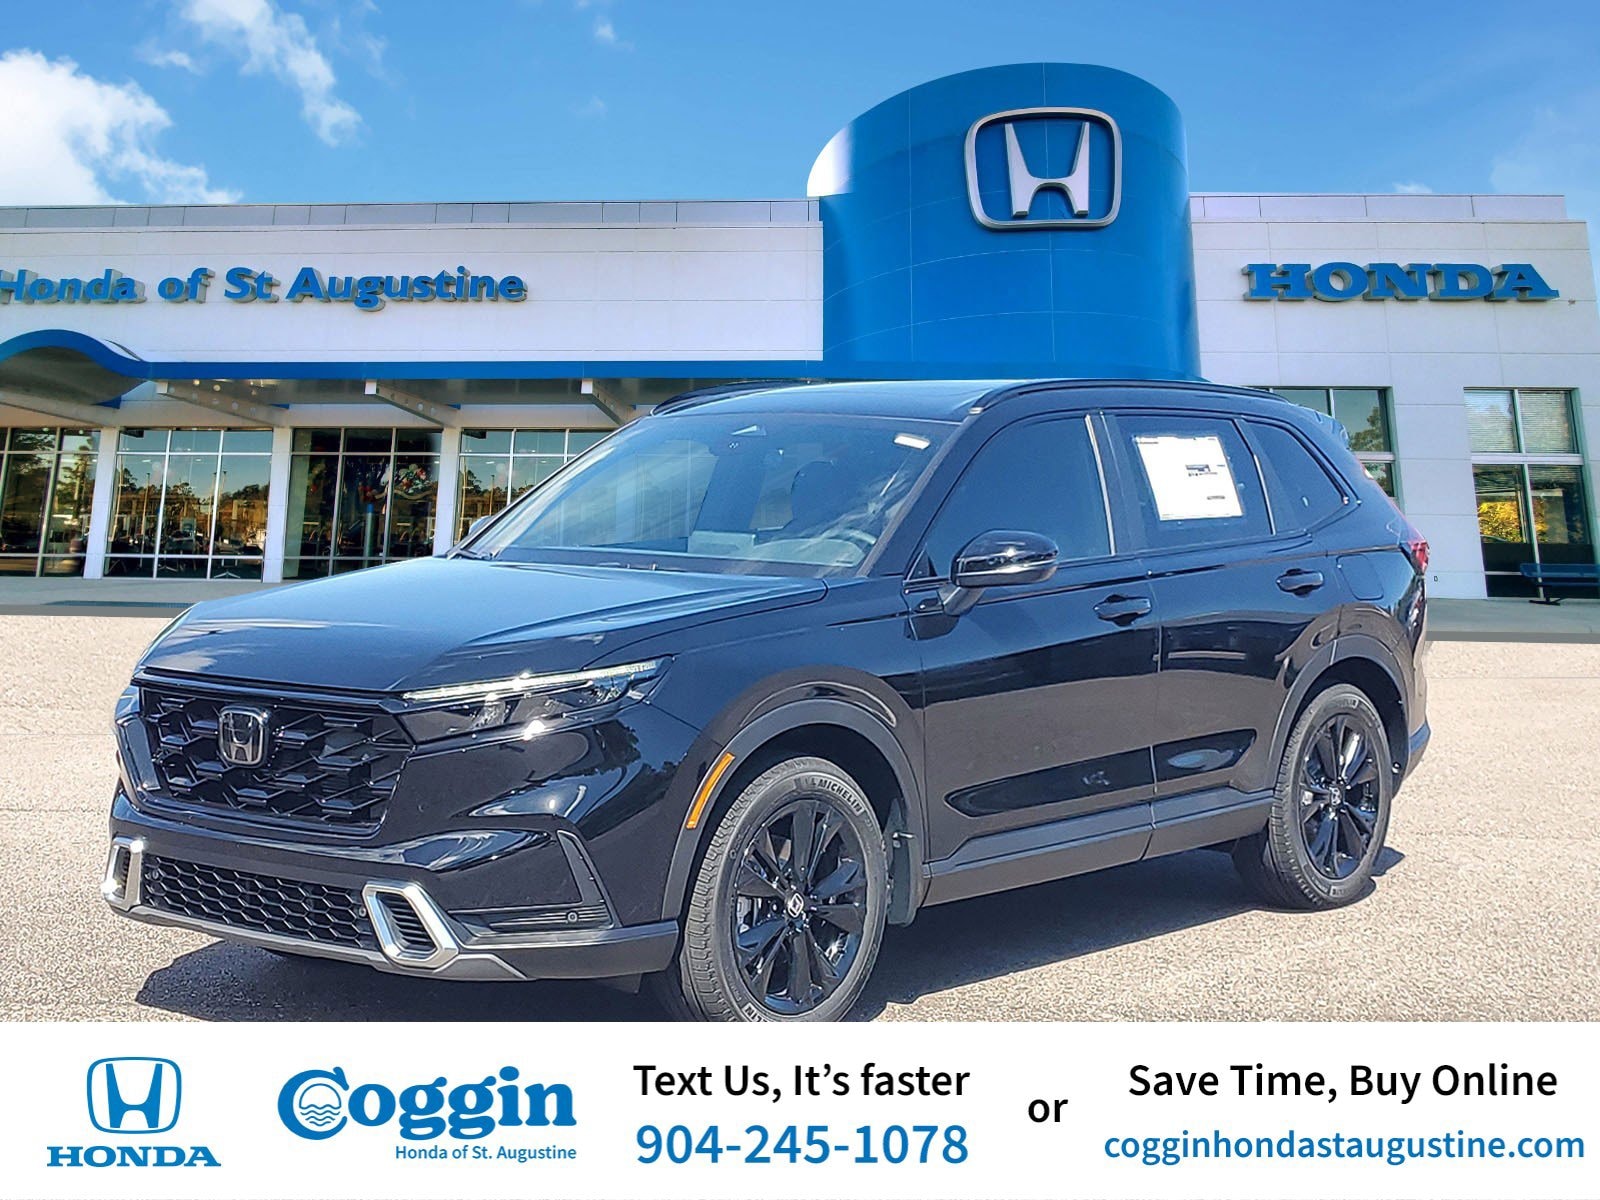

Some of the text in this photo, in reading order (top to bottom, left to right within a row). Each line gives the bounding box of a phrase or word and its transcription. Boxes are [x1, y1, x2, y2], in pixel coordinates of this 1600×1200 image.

[0, 265, 527, 312] Honda of St Augustine
[1242, 261, 1560, 302] HONDA
[818, 778, 863, 813] MICHELIN
